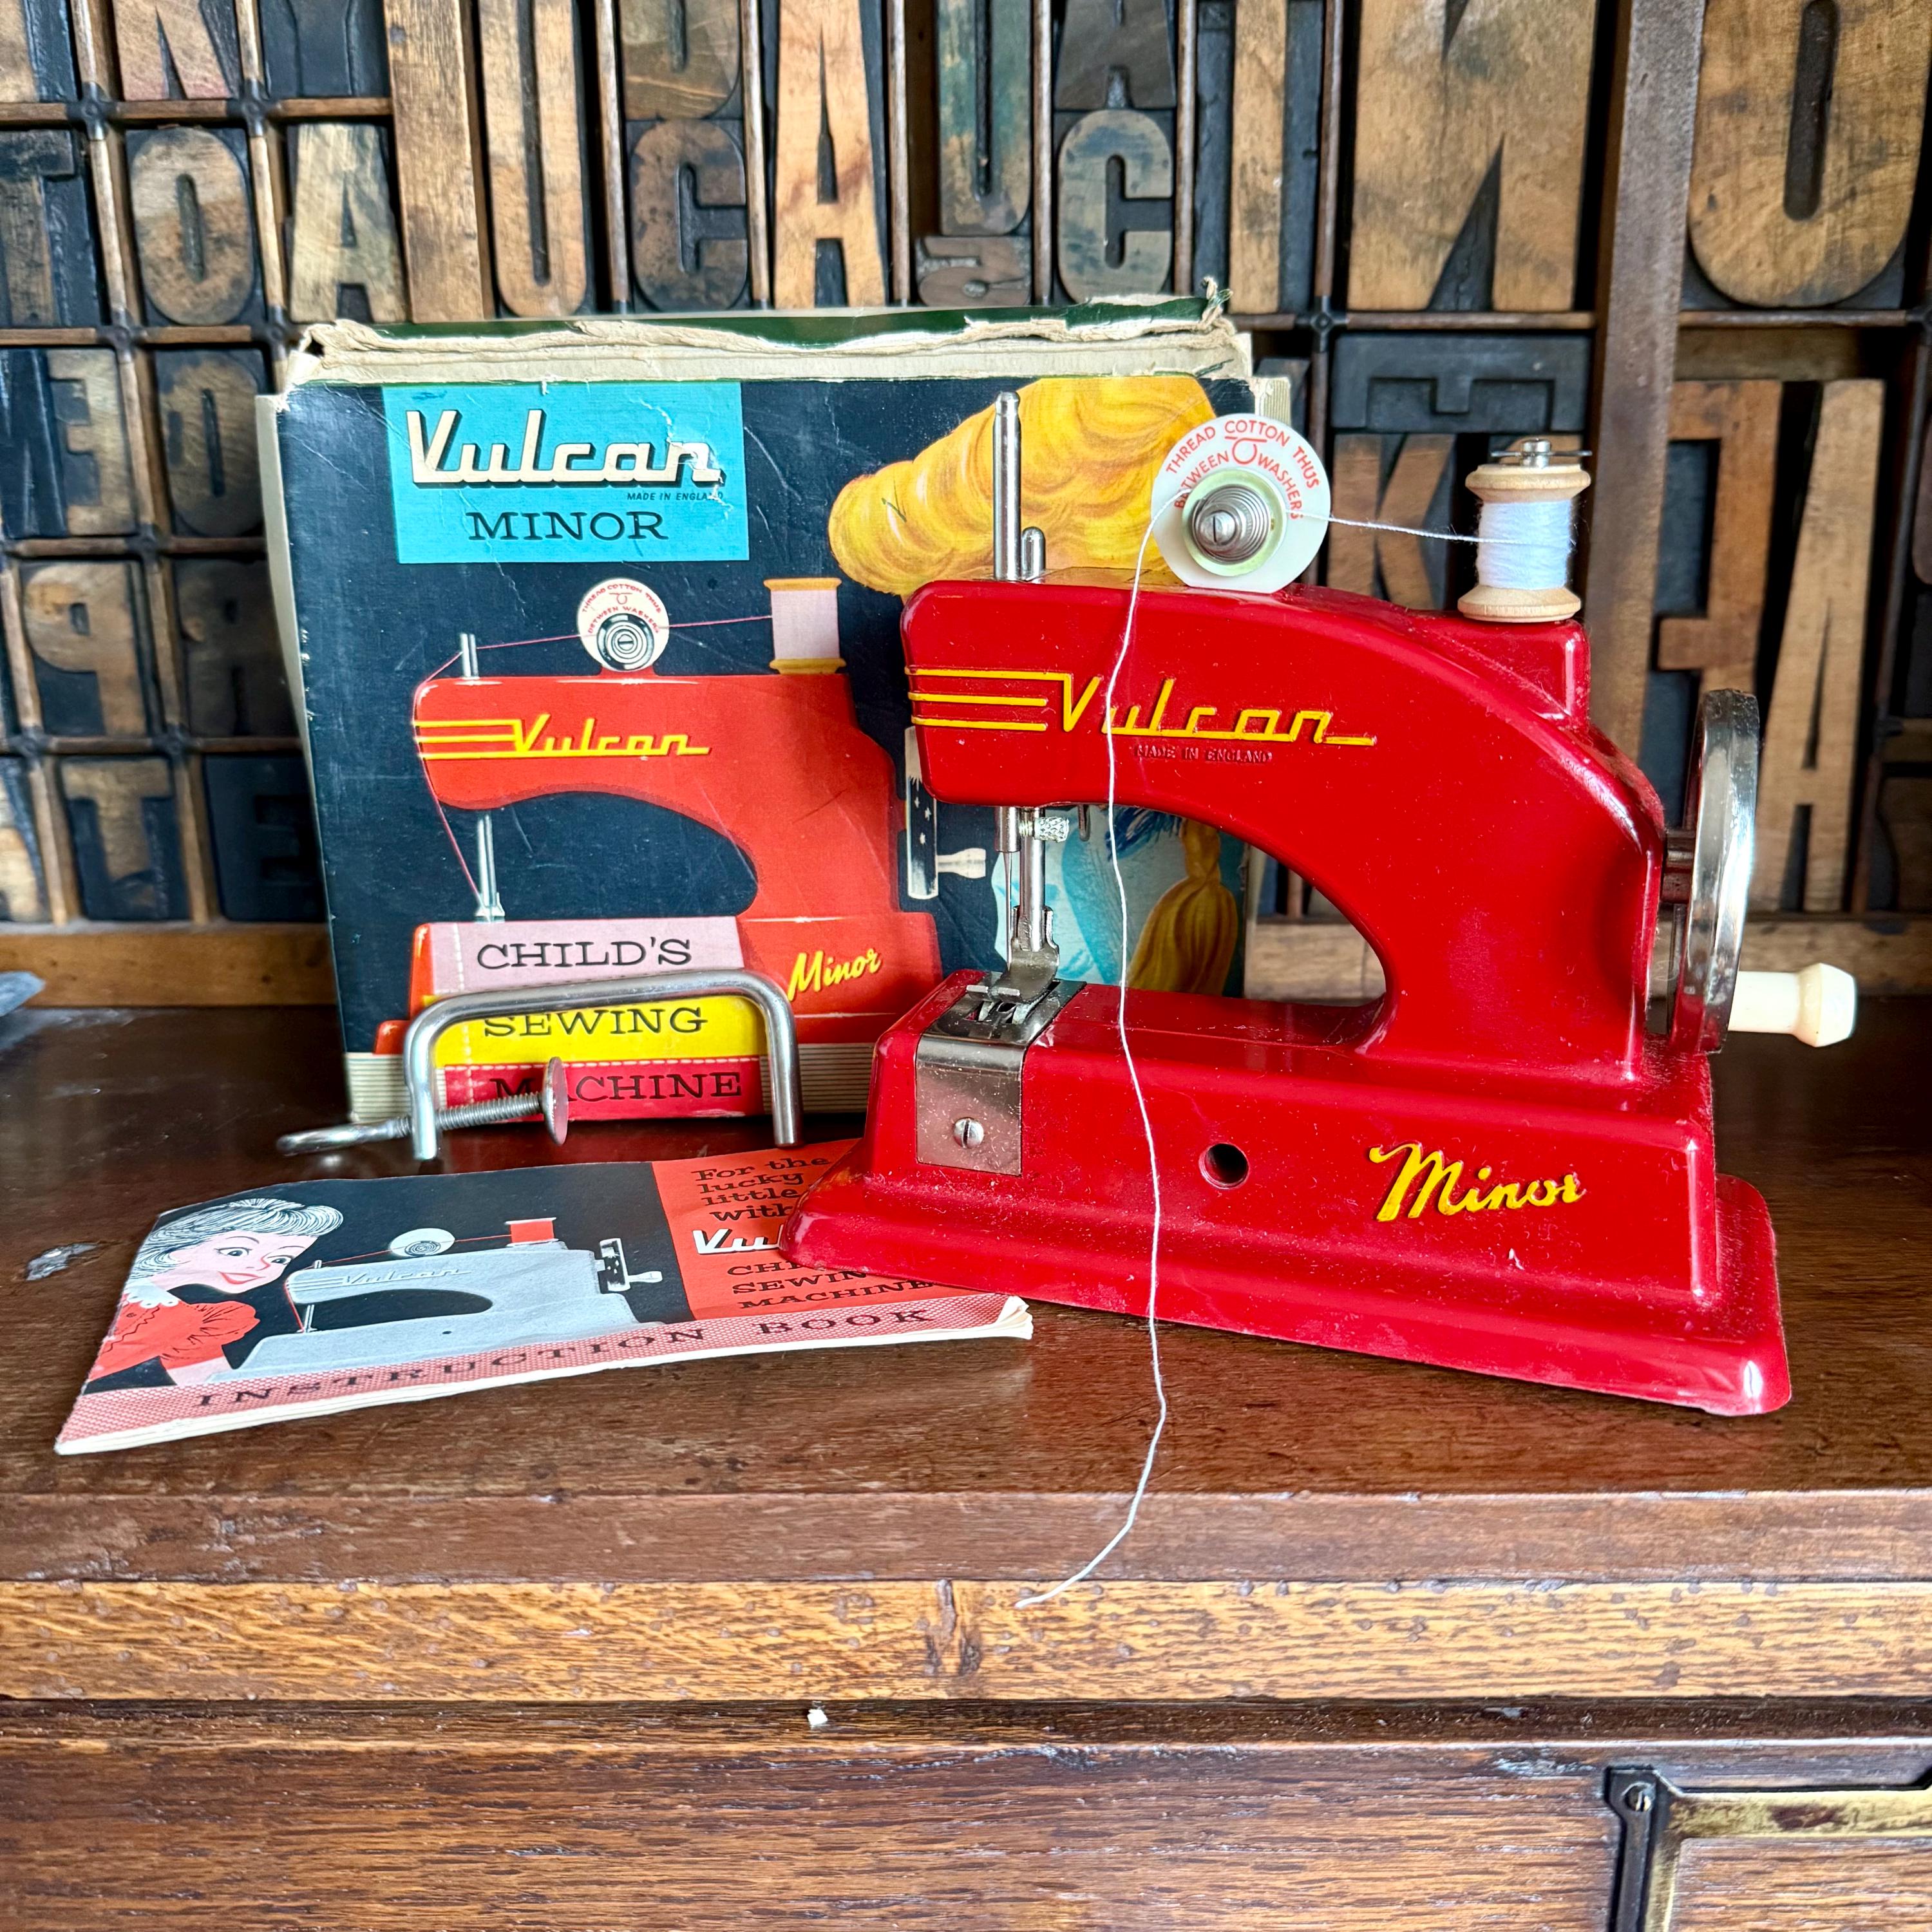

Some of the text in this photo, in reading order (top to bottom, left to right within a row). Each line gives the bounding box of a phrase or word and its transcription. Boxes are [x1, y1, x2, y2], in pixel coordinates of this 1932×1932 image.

[406, 410, 726, 488] Vulcan
[1166, 420, 1320, 489] THREAD COTTON THUS
[627, 491, 723, 501] MADE IN ENGLAD
[465, 511, 669, 541] MINOR
[607, 583, 643, 593] COTTON
[1059, 672, 1378, 746] Vulcan
[513, 714, 711, 759] Vulcan
[477, 936, 692, 969] CHILD'S
[788, 947, 882, 1002] Minor
[484, 1006, 709, 1037] SEWING
[489, 1072, 743, 1104] MCHINE
[691, 1157, 831, 1182] For the
[697, 1172, 804, 1194] lucky
[1368, 1141, 1587, 1223] Minor
[701, 1188, 802, 1206] little
[345, 1269, 471, 1285] Vulcan
[737, 1278, 934, 1309] MACHINE
[198, 1309, 936, 1408] INSTRUCTION BOOK
